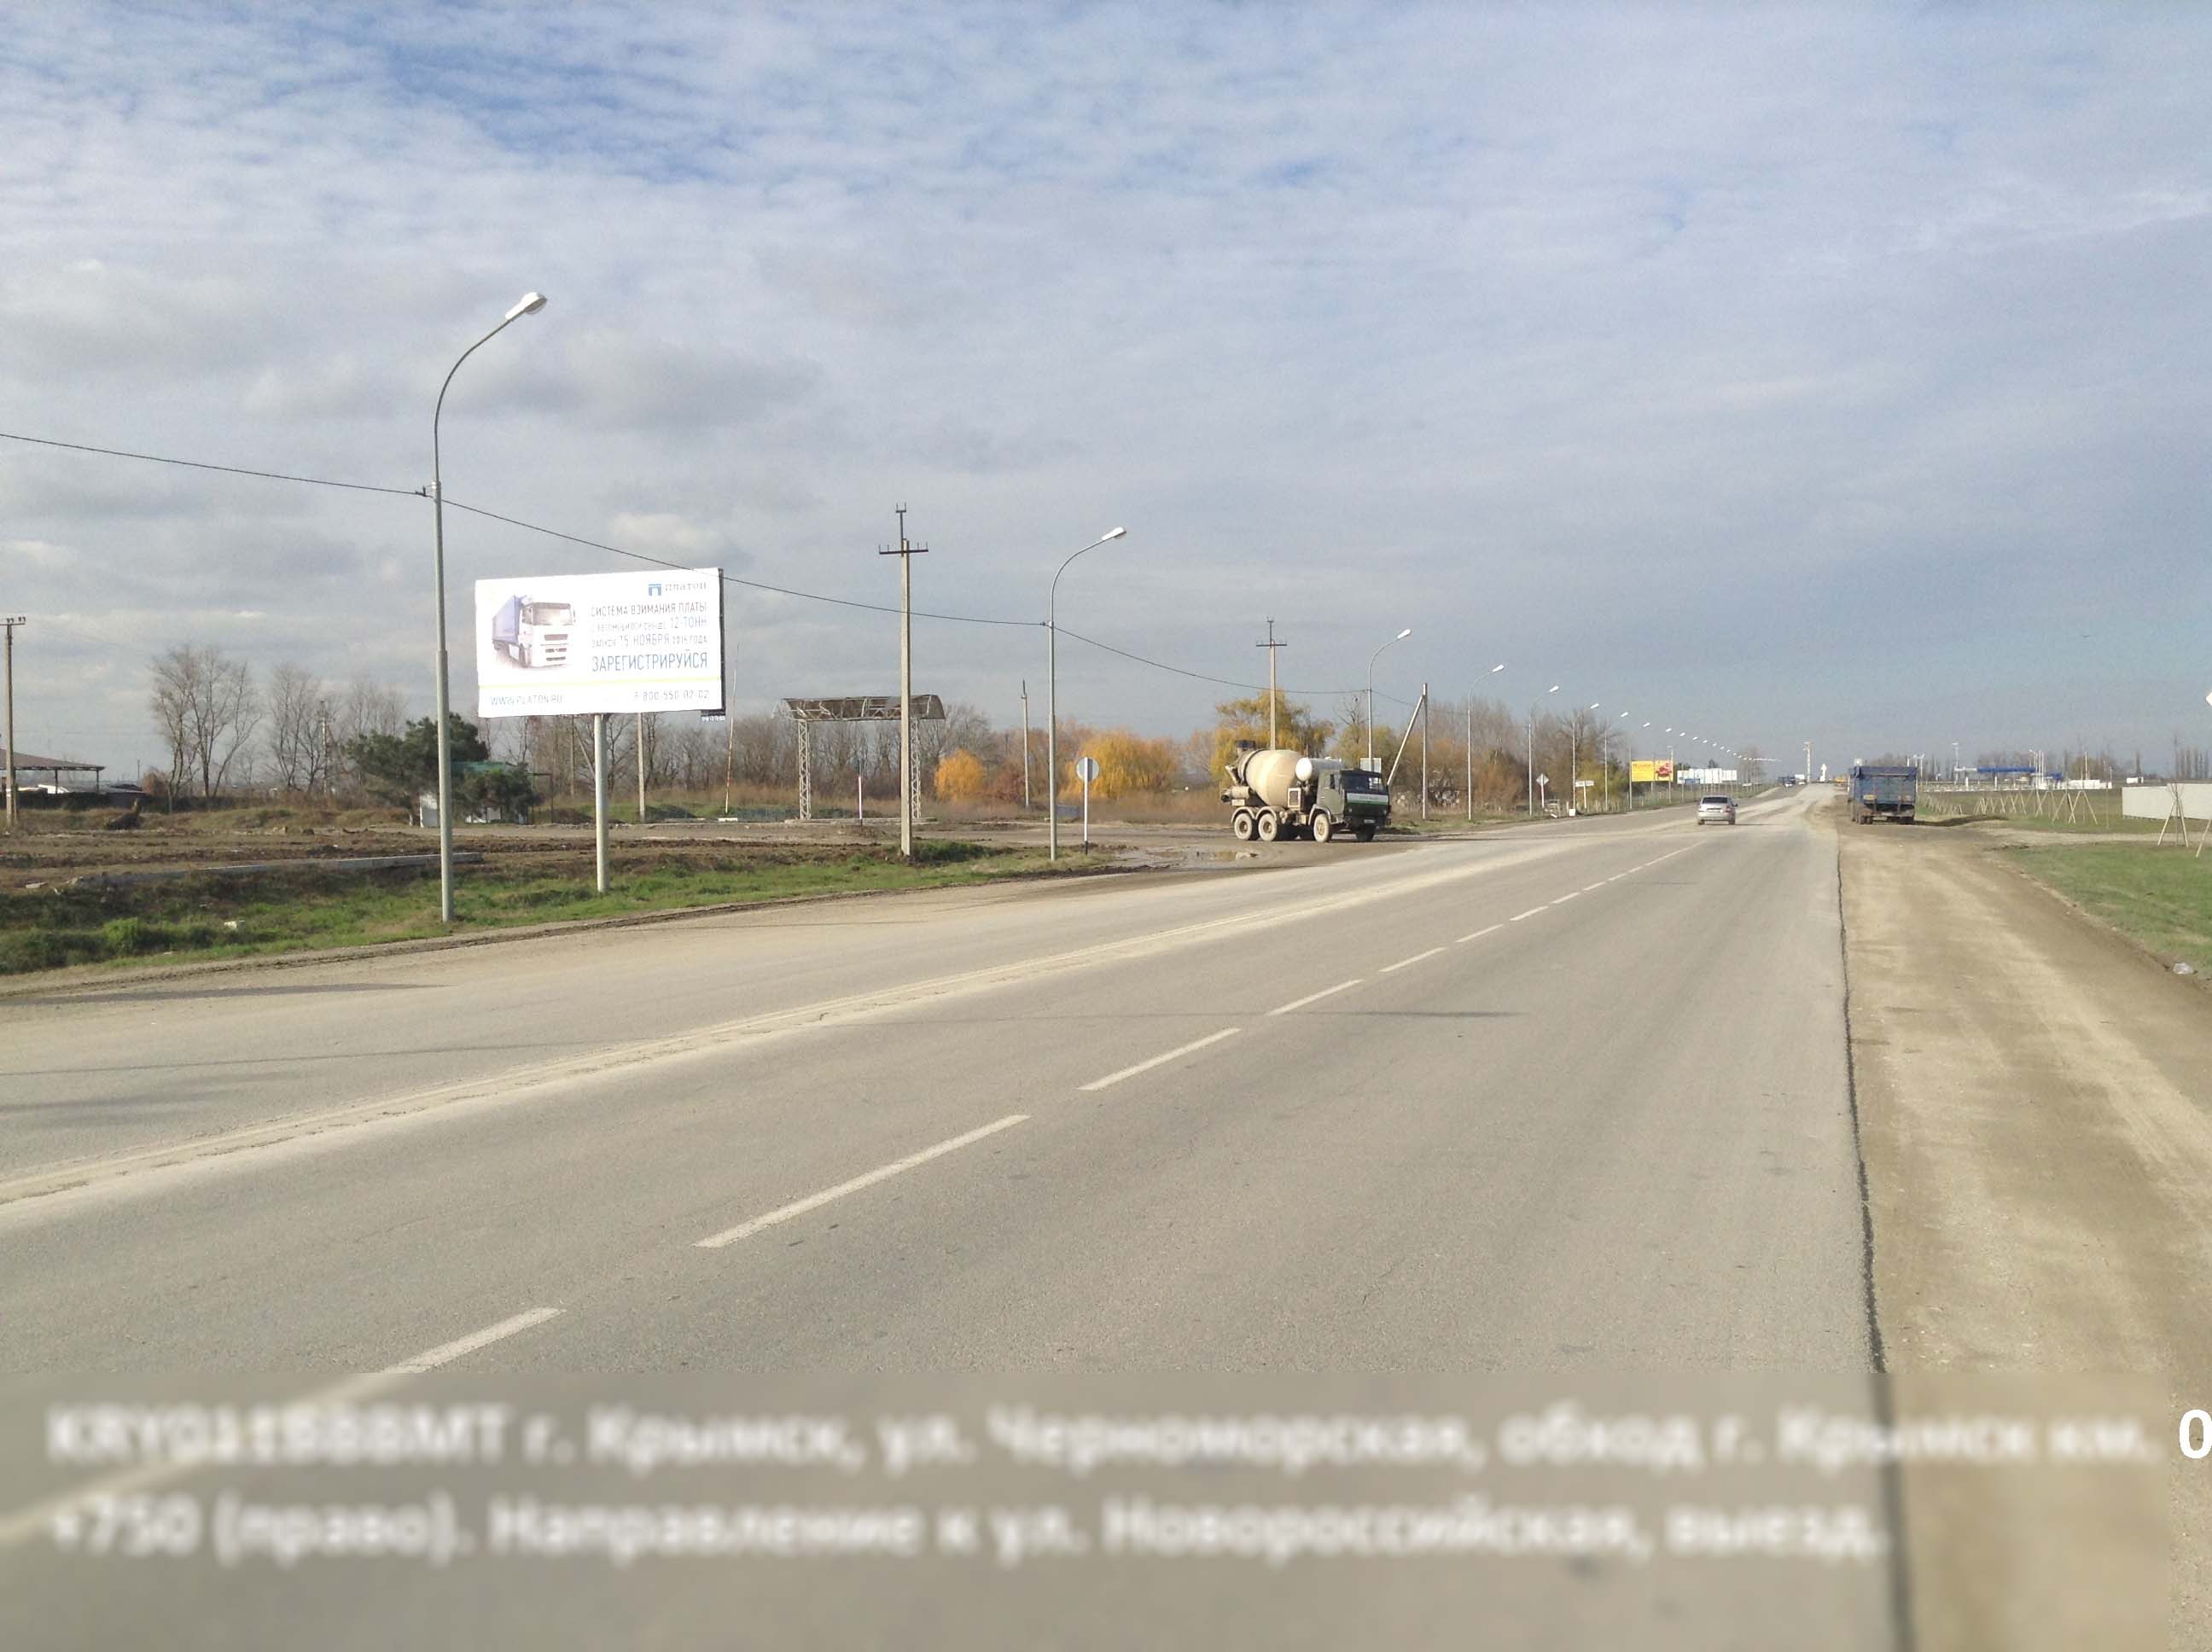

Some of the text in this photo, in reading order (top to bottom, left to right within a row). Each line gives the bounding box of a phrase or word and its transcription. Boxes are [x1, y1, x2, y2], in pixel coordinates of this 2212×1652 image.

[591, 601, 707, 617] СИСТЕМА ВЗИМАНИЯ ПЛАТЫ
[633, 633, 670, 646] НОЯБРЯ
[591, 649, 707, 672] ЗАРЕГИСТРИРУЙСЯ
